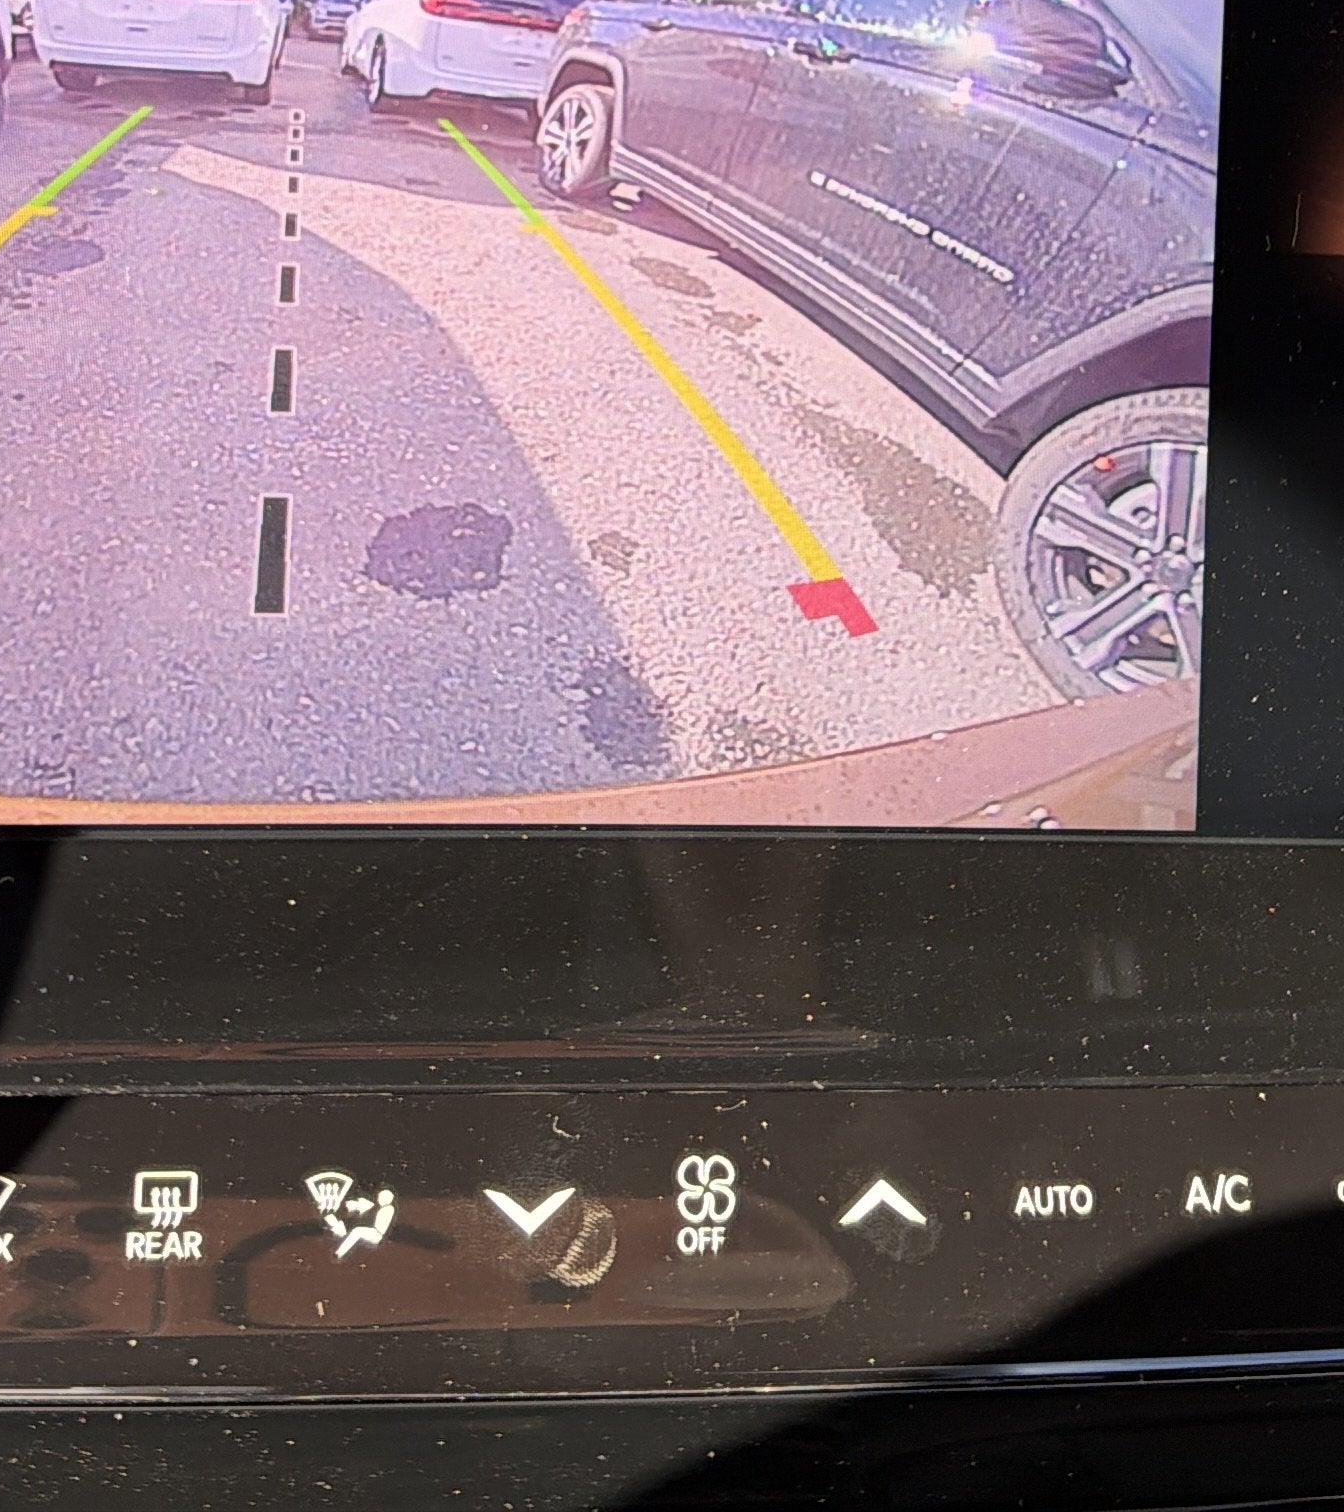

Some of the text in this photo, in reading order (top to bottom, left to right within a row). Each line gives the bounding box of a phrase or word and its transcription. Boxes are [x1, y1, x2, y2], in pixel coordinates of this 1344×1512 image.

[1013, 1184, 1093, 1217] AUTO
[1184, 1173, 1252, 1215] A/C
[125, 1231, 204, 1261] REAR
[676, 1226, 726, 1256] OFF
